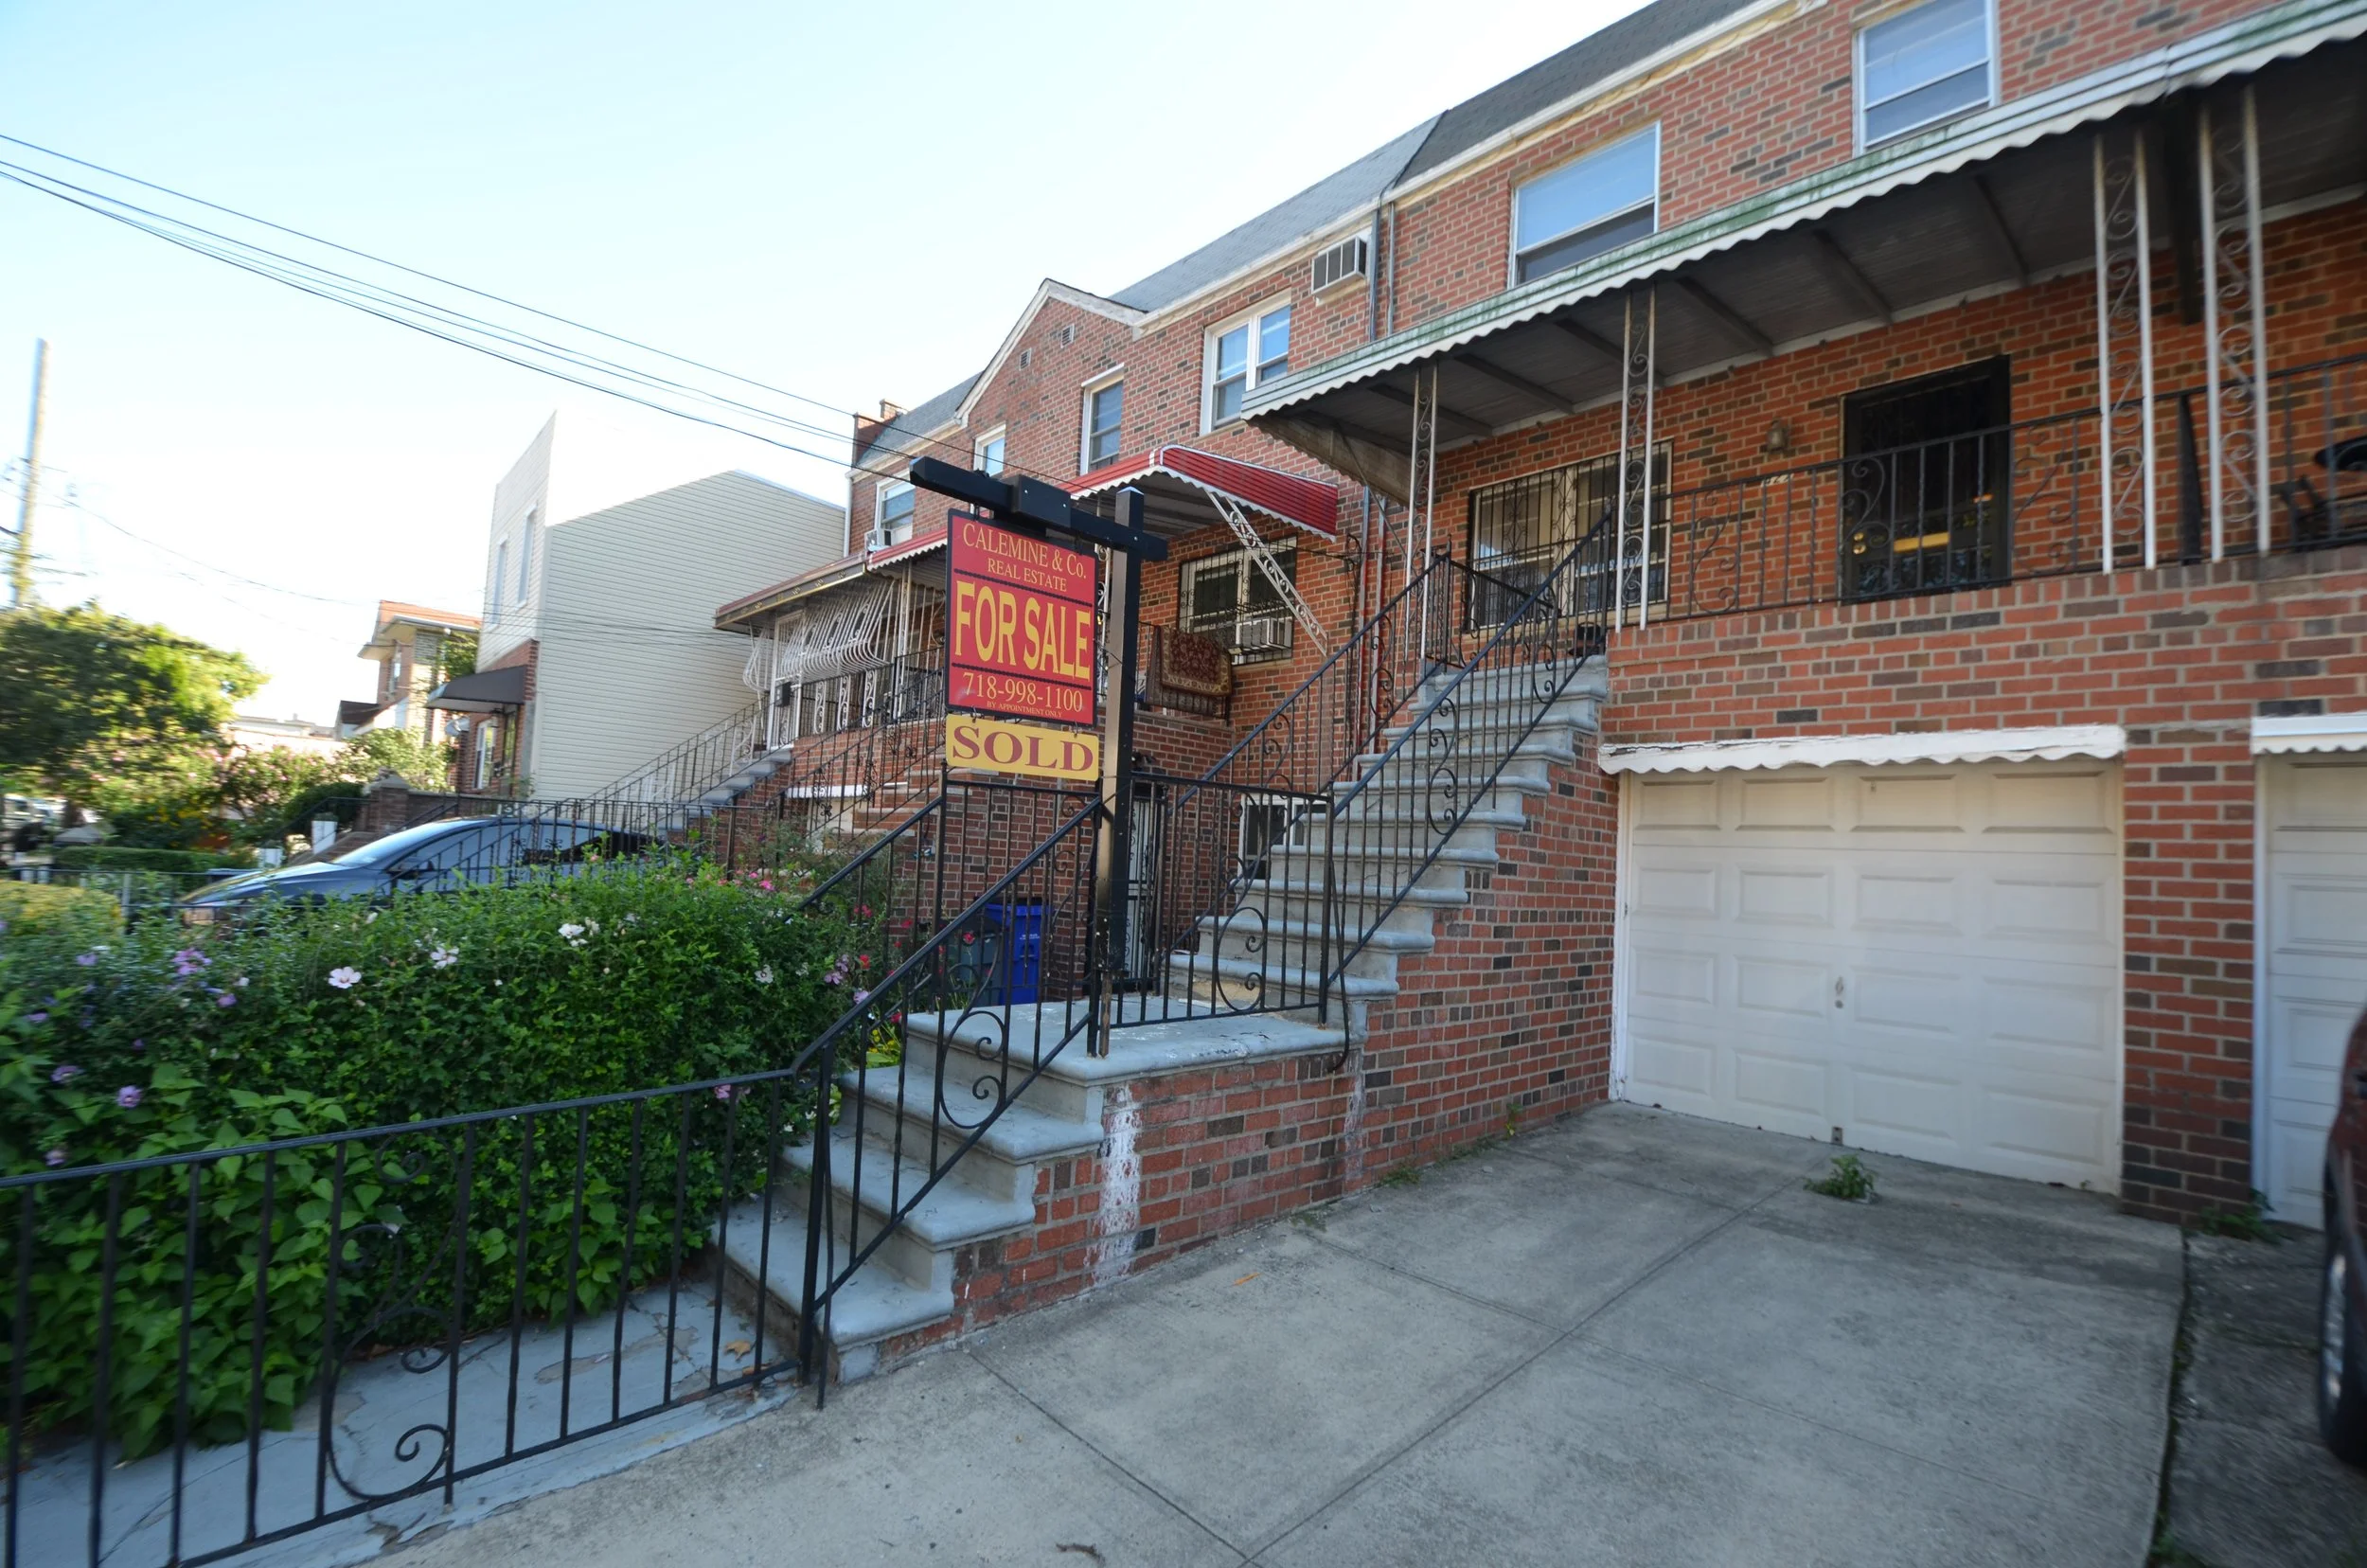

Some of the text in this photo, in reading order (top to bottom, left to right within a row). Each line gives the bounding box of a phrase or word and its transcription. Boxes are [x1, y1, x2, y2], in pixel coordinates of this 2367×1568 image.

[963, 523, 1087, 579] CALEMINE & Co.
[988, 558, 1067, 592] REAL ESTATE
[954, 580, 1091, 682] FOR SALE
[963, 671, 1083, 712] 718-998-1100
[999, 703, 1044, 716] APPOINTMENT
[1044, 710, 1063, 719] ONLY
[952, 725, 1094, 772] SOLD
